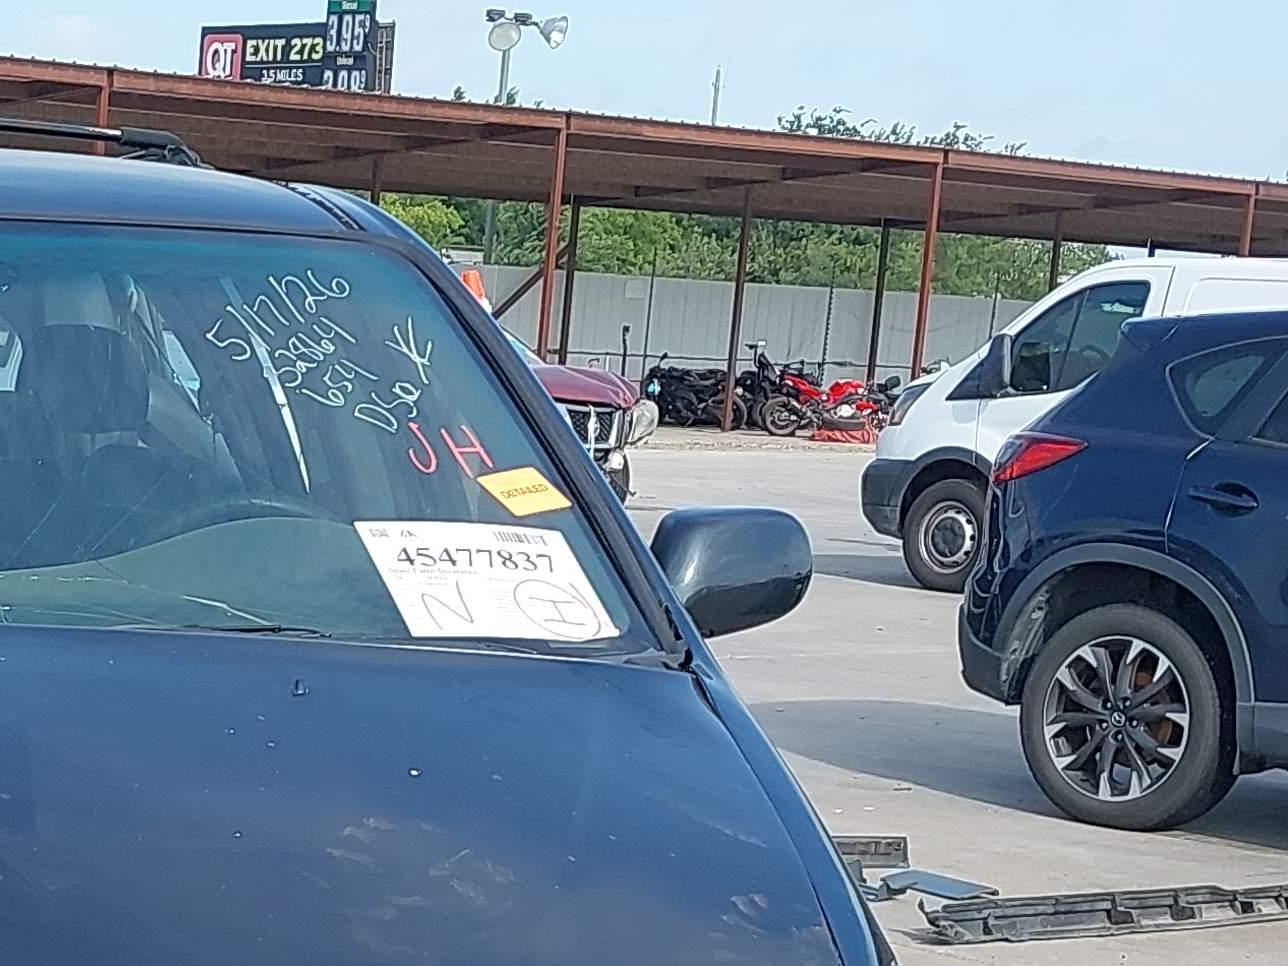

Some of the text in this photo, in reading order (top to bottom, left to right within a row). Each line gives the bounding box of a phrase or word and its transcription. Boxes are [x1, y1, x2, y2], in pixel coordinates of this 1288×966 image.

[206, 41, 236, 78] QT
[245, 38, 286, 62] EXIT
[289, 37, 324, 61] 273
[276, 68, 304, 82] MILES
[500, 483, 549, 499] DETAILED
[396, 546, 554, 574] 45477837
